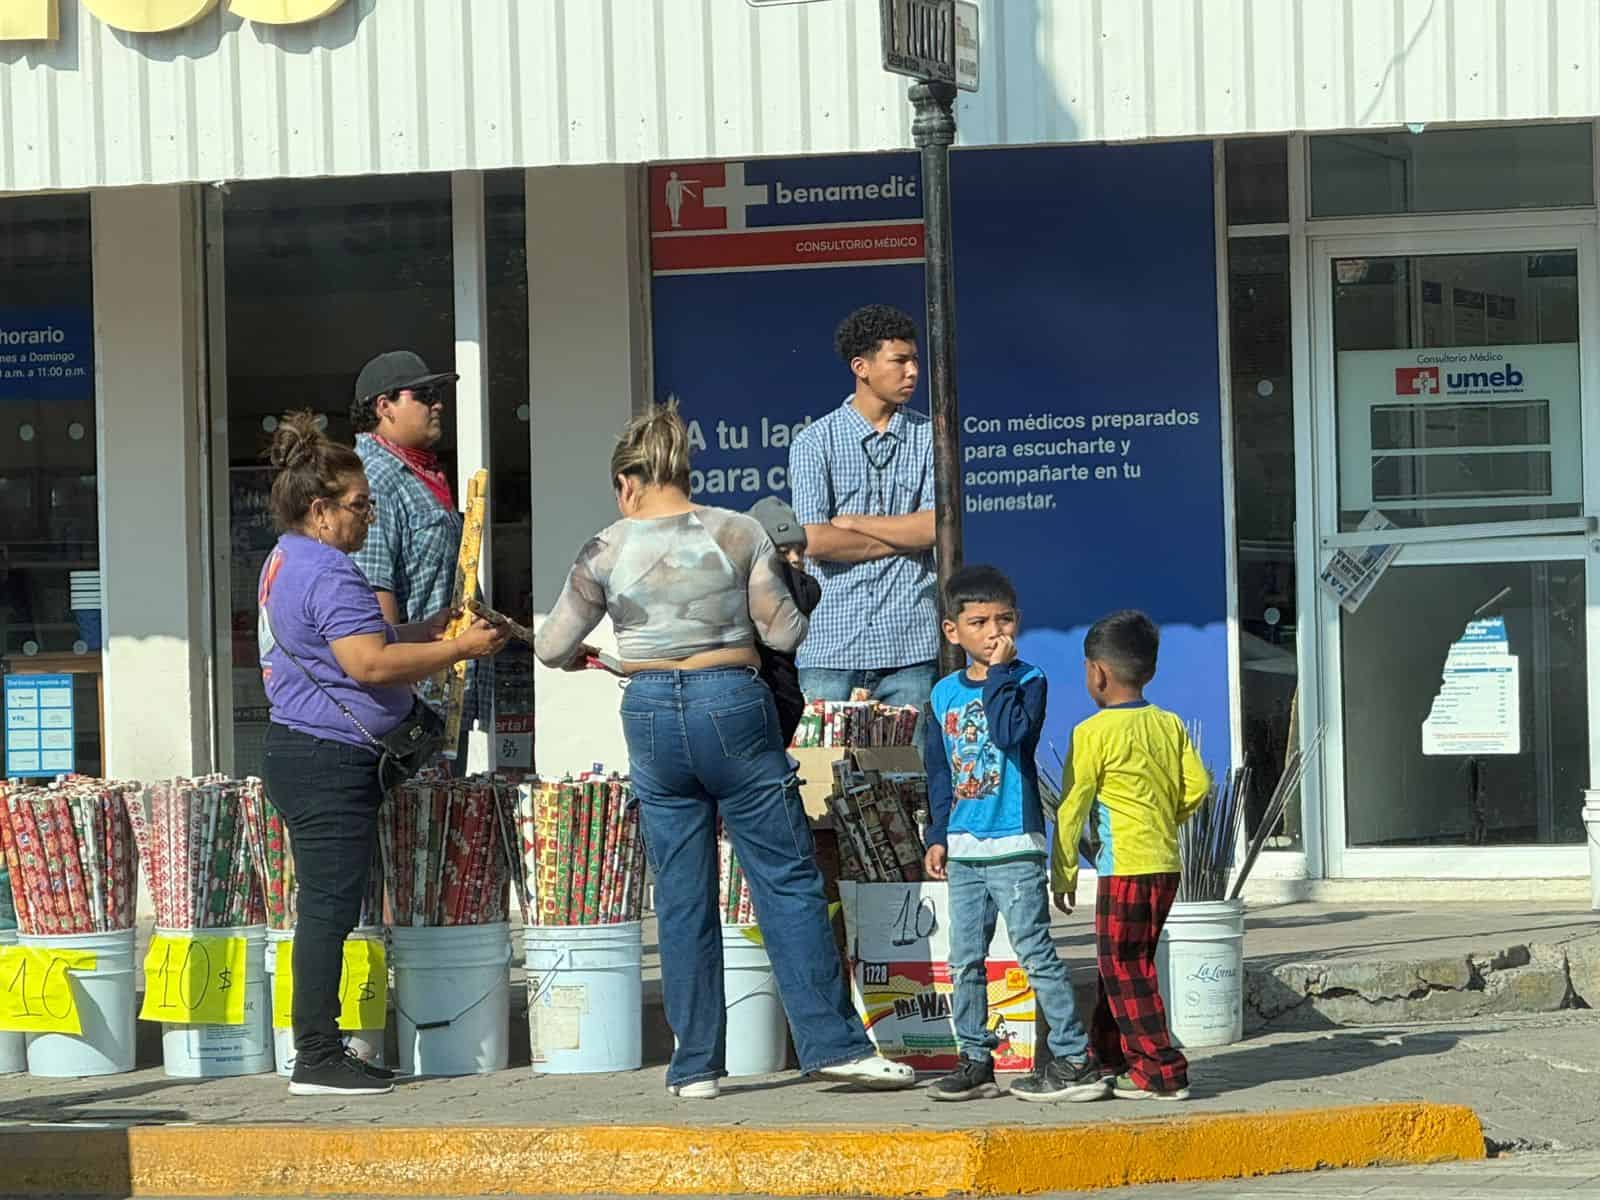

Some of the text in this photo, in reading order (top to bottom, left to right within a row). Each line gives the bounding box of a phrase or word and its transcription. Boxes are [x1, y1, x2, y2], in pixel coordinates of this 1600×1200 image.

[796, 236, 918, 252] CONSULTORIO MÉDICO
[29, 352, 75, 363] Domingo
[1417, 351, 1503, 364] Consultorio Médico
[38, 367, 63, 377] 11:00
[1447, 363, 1523, 388] umeb
[964, 409, 1200, 433] Con médicos preparados
[687, 420, 706, 450] A
[716, 420, 748, 449] tu
[964, 438, 1131, 462] para escucharte y
[965, 462, 1141, 486] acompañarte en tu
[966, 491, 1057, 513] bienestar.
[892, 890, 938, 946] 10
[157, 941, 210, 1010] 10
[218, 967, 232, 993] $
[8, 957, 72, 1019] 10
[358, 980, 375, 1005] $
[917, 991, 953, 1019] WA
